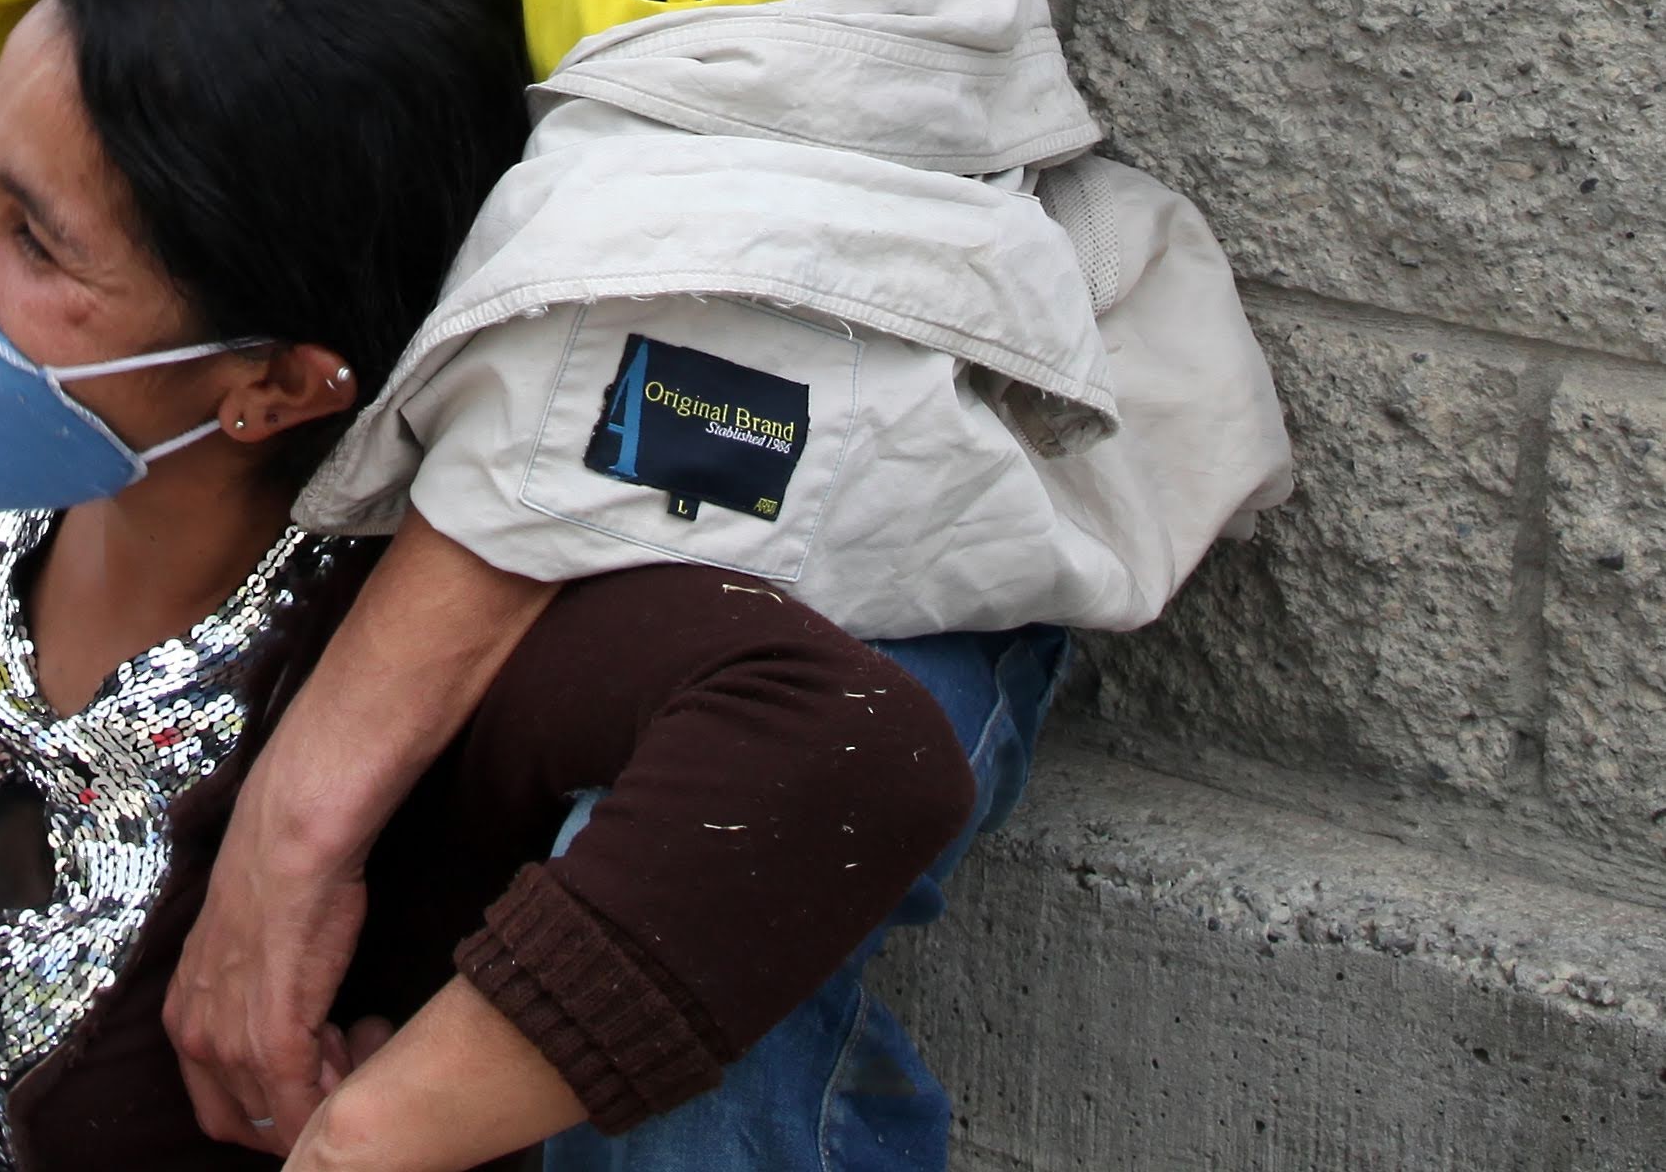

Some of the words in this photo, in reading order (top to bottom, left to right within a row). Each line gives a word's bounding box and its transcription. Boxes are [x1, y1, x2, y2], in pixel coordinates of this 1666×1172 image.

[645, 381, 729, 424] Original
[735, 407, 795, 442] Brand
[705, 420, 766, 448] Stablished
[765, 435, 792, 454] 1986
[677, 499, 688, 515] L
